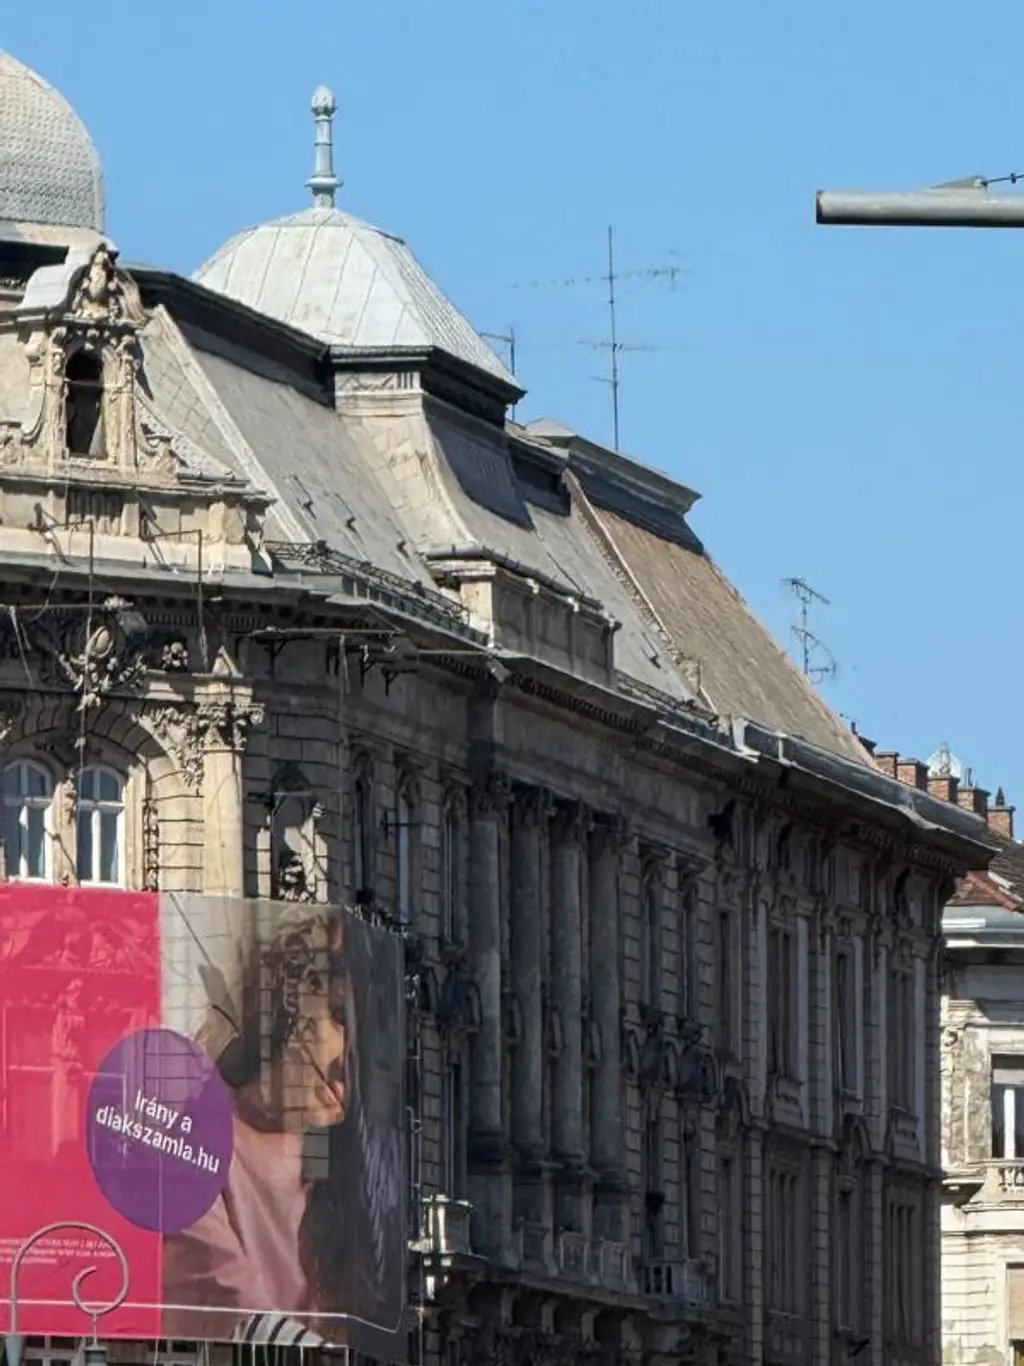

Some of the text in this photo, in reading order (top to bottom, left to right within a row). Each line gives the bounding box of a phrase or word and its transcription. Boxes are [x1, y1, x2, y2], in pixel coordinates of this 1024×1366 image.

[134, 1089, 193, 1134] Irány a
[96, 1106, 220, 1174] diakszamla.hu
